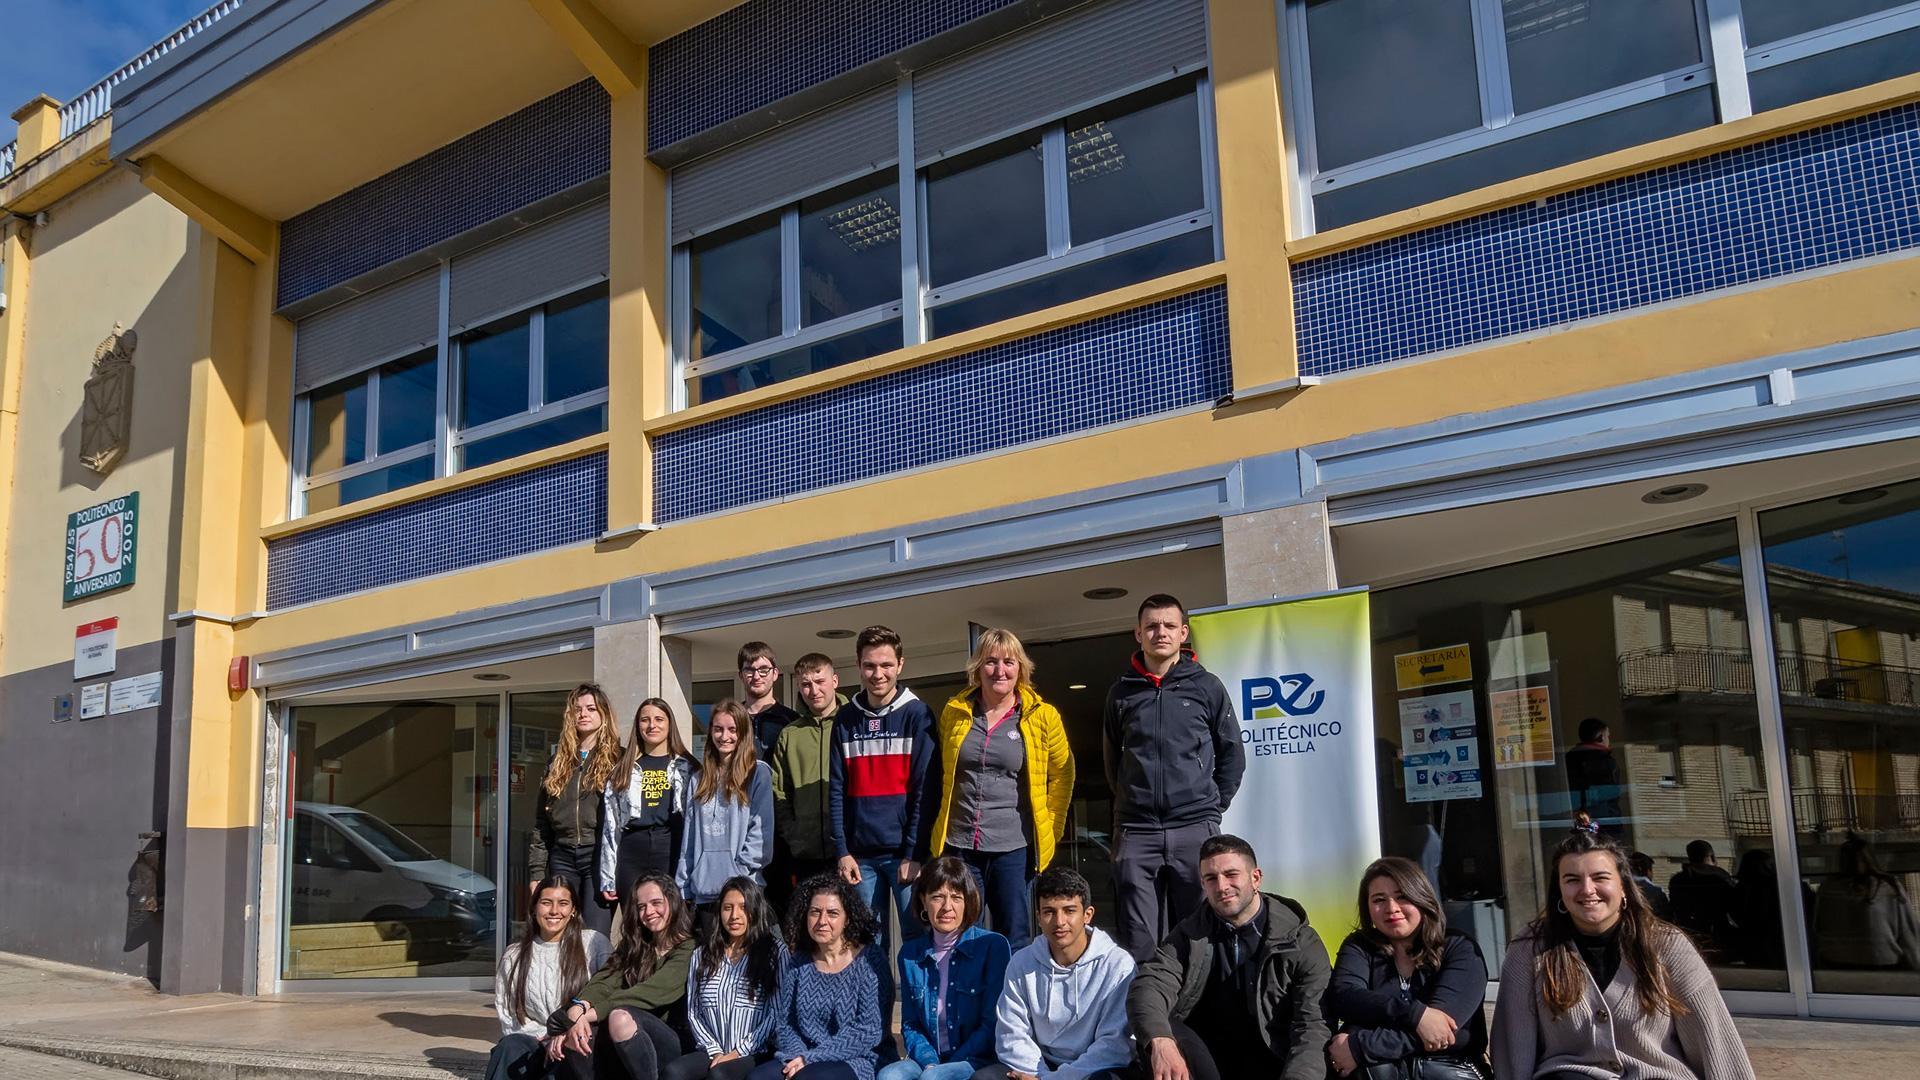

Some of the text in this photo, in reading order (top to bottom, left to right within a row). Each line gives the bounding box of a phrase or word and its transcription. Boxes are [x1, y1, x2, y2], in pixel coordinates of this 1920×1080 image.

[77, 499, 125, 525] POLITECNICO
[76, 516, 121, 580] 50
[123, 510, 133, 566] 2005
[66, 529, 75, 584] 1954/55
[73, 571, 121, 596] ANIVERSARIO
[1240, 721, 1341, 743] OLITÉCNICO
[1255, 741, 1315, 756] ESTELLA
[645, 790, 663, 799] DEN
